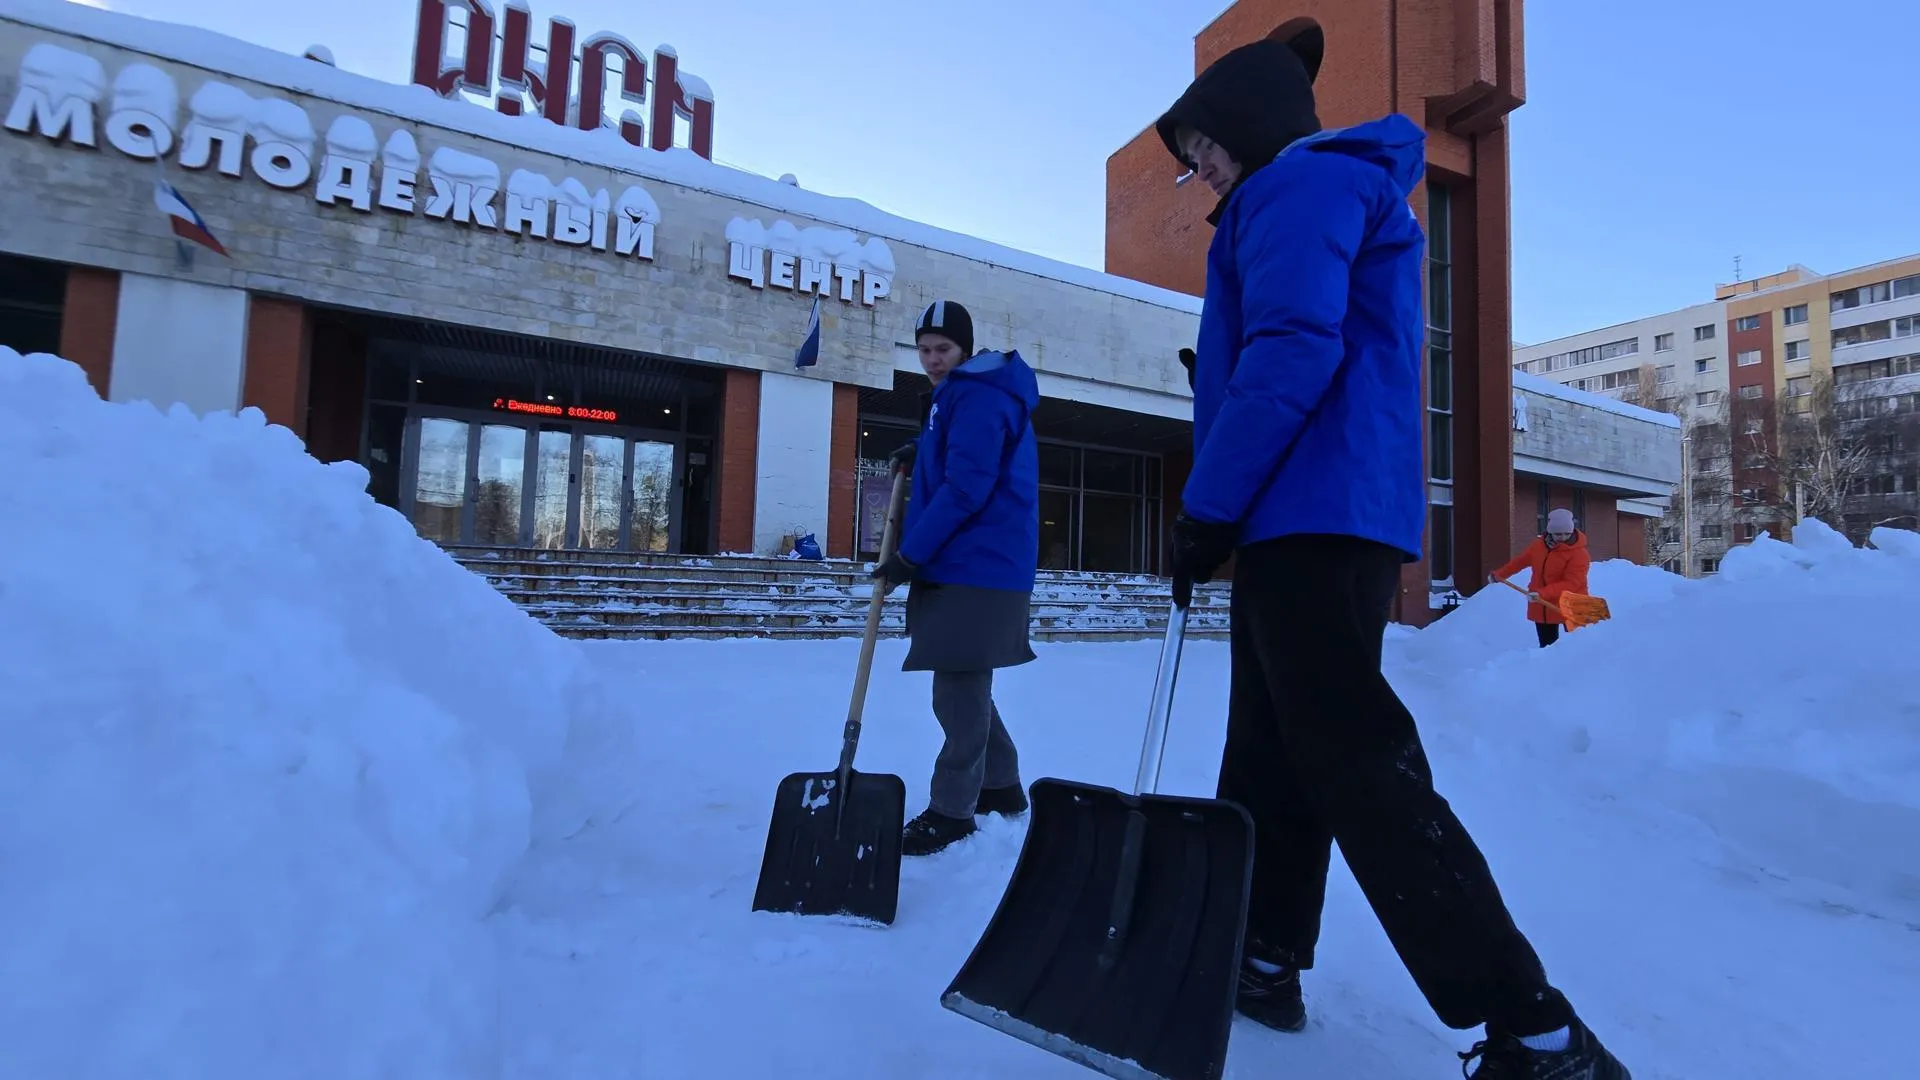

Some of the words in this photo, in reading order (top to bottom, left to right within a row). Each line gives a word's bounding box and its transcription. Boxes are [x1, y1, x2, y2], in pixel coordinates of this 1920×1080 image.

[3, 83, 656, 262] МОЛОДЕЖНЫЙ
[728, 240, 892, 307] ЦЕНТР
[508, 400, 563, 415] Ежедневно
[568, 407, 617, 421] 8:00-22:00
